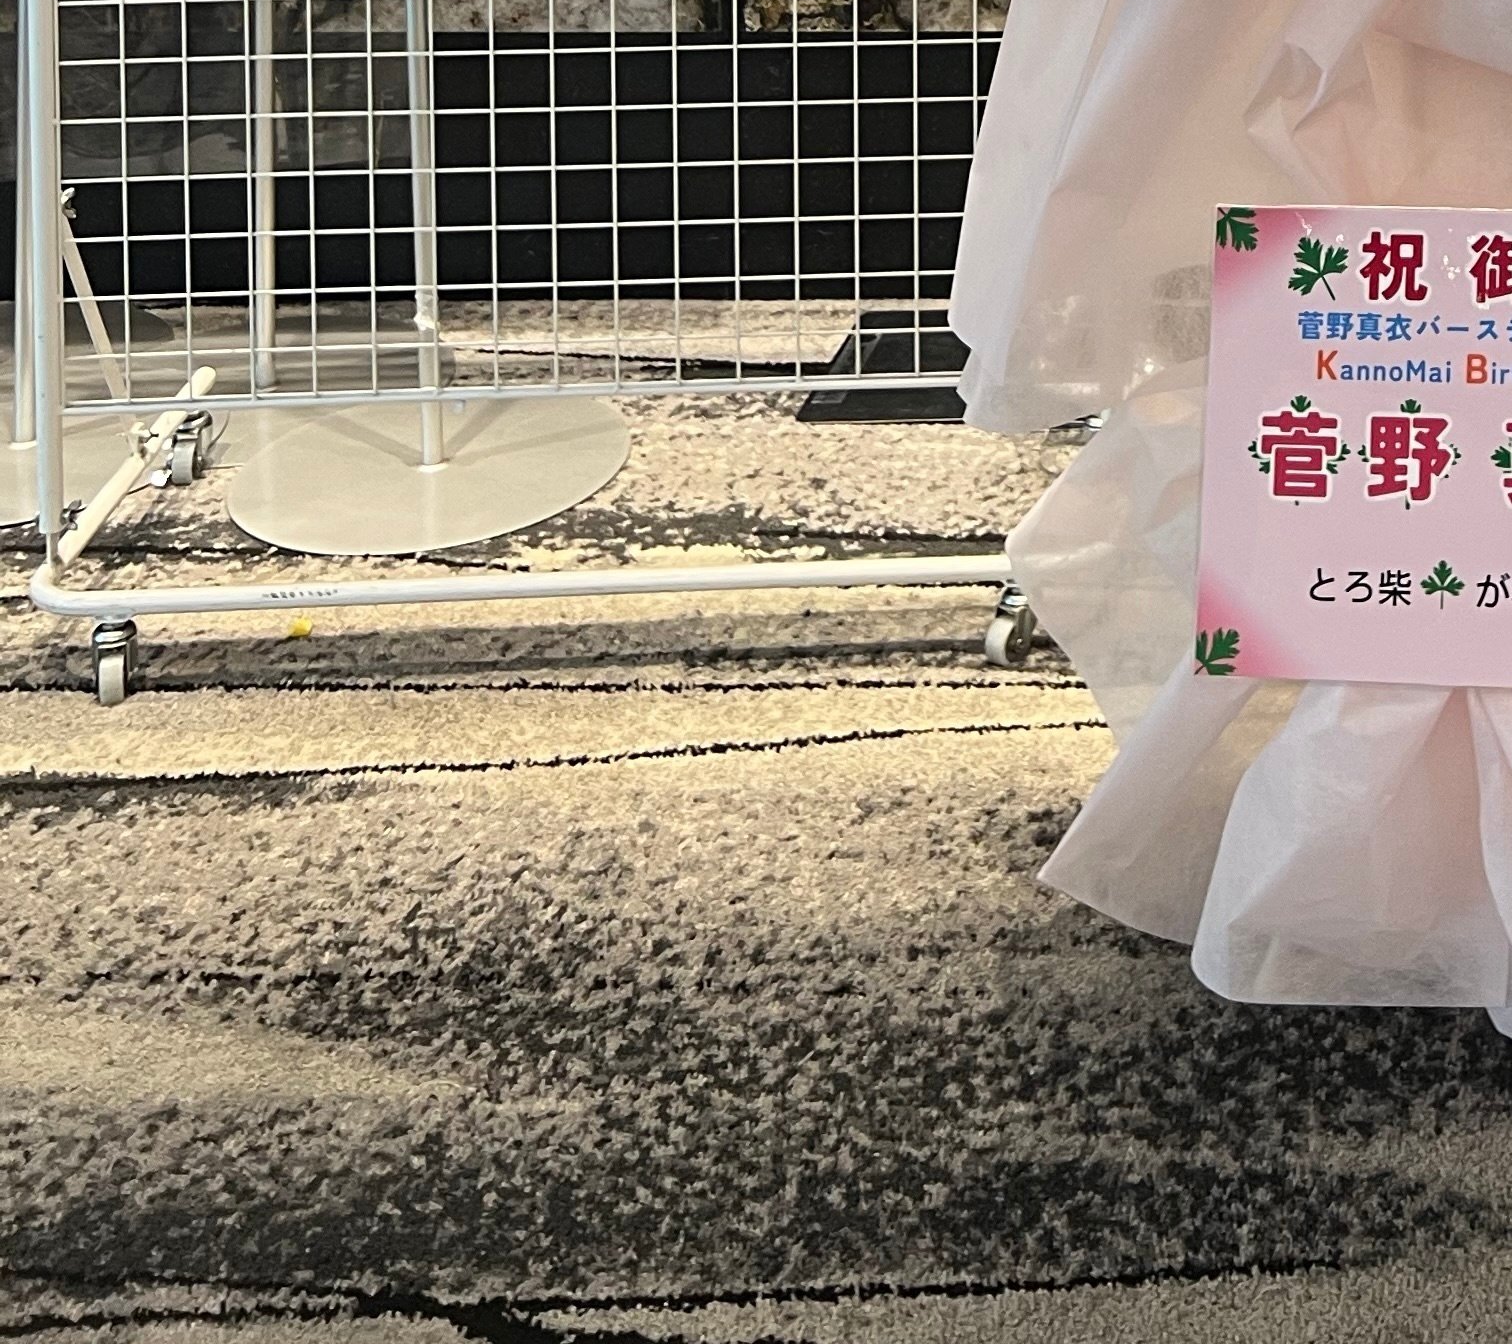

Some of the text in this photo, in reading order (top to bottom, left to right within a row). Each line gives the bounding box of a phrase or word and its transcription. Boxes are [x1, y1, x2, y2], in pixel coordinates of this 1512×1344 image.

[1359, 231, 1428, 302] 祝
[1315, 350, 1453, 384] KannoMai
[1308, 568, 1412, 606] とろ柴
